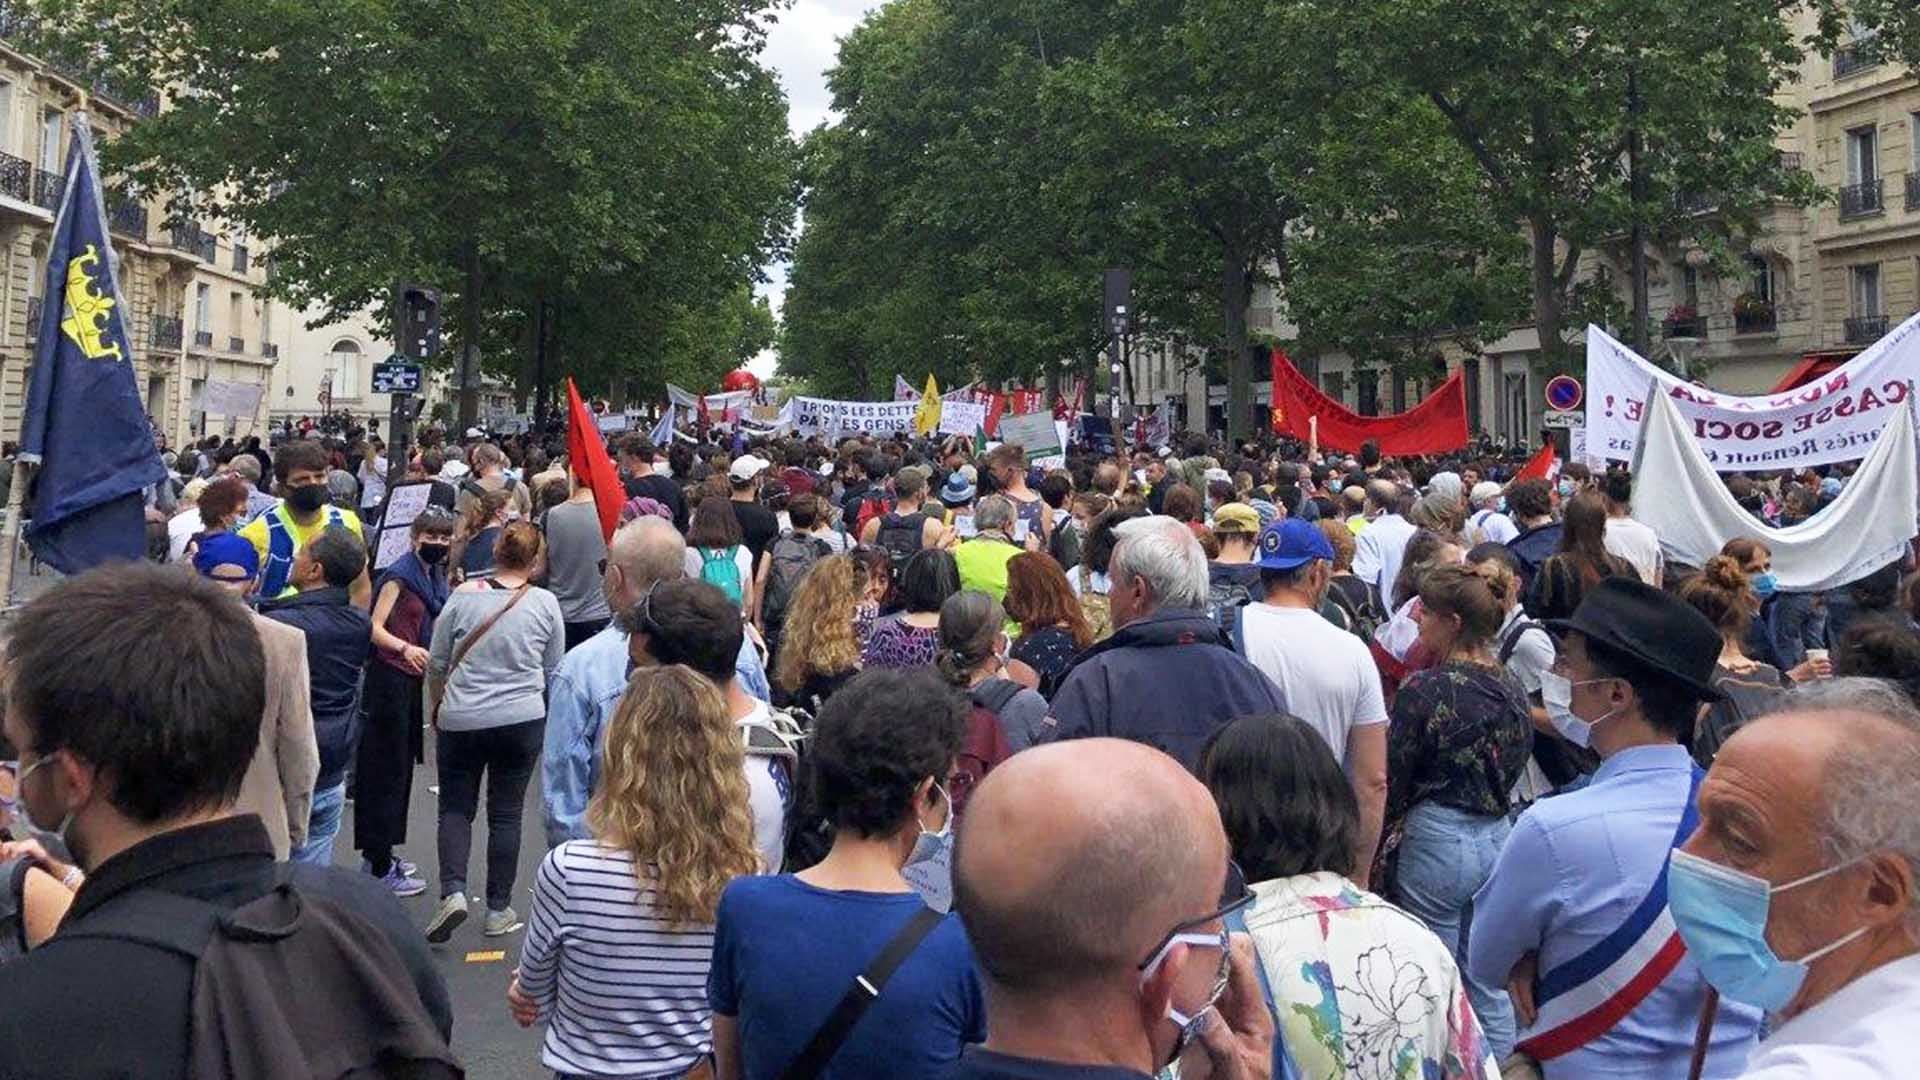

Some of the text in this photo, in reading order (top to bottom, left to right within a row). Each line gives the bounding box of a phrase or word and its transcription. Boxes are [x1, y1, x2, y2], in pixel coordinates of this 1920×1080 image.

[851, 406, 874, 417] LES
[878, 404, 919, 417] DETTE
[864, 418, 905, 431] GENS
